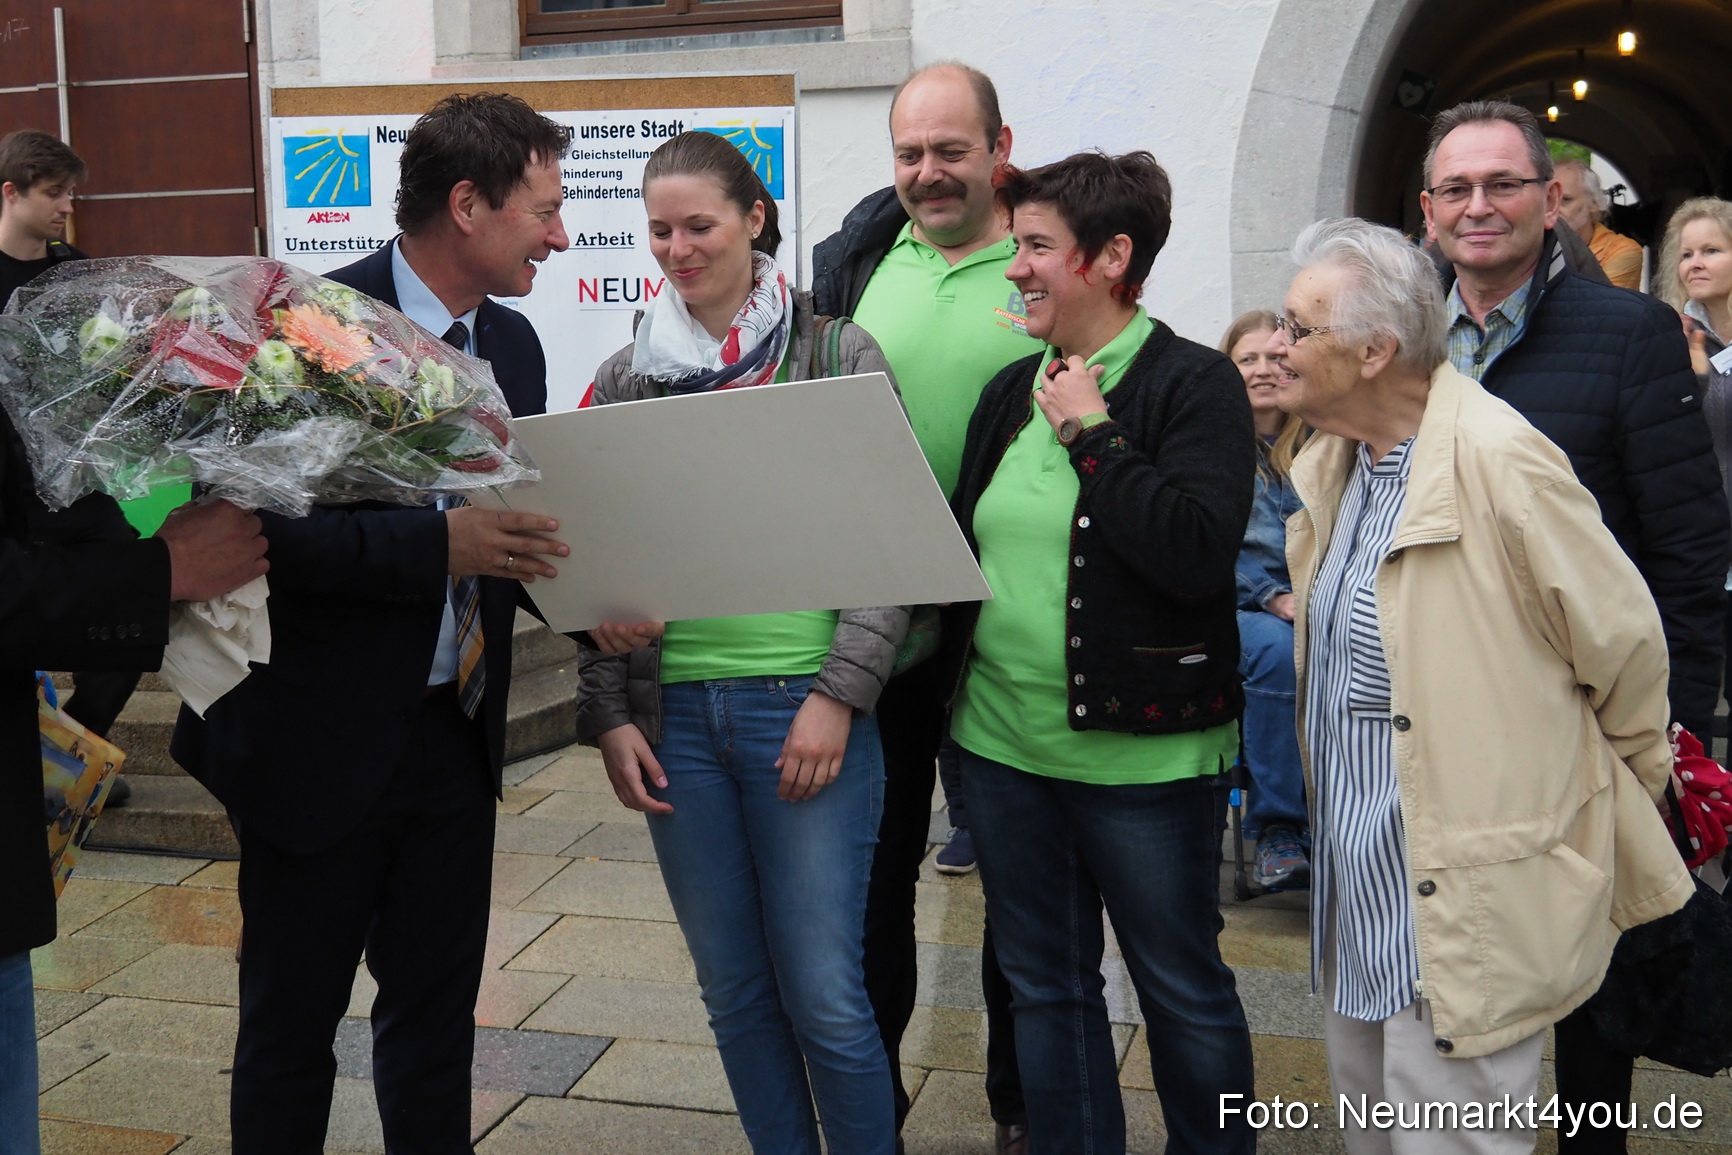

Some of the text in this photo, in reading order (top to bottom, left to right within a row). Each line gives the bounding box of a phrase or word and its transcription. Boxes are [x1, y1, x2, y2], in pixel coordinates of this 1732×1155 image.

[376, 126, 411, 143] Neu
[581, 124, 636, 138] unsere
[641, 120, 684, 137] Stadt
[560, 169, 623, 180] hinderung
[562, 186, 644, 199] Behindertena
[575, 232, 635, 246] Arbeit
